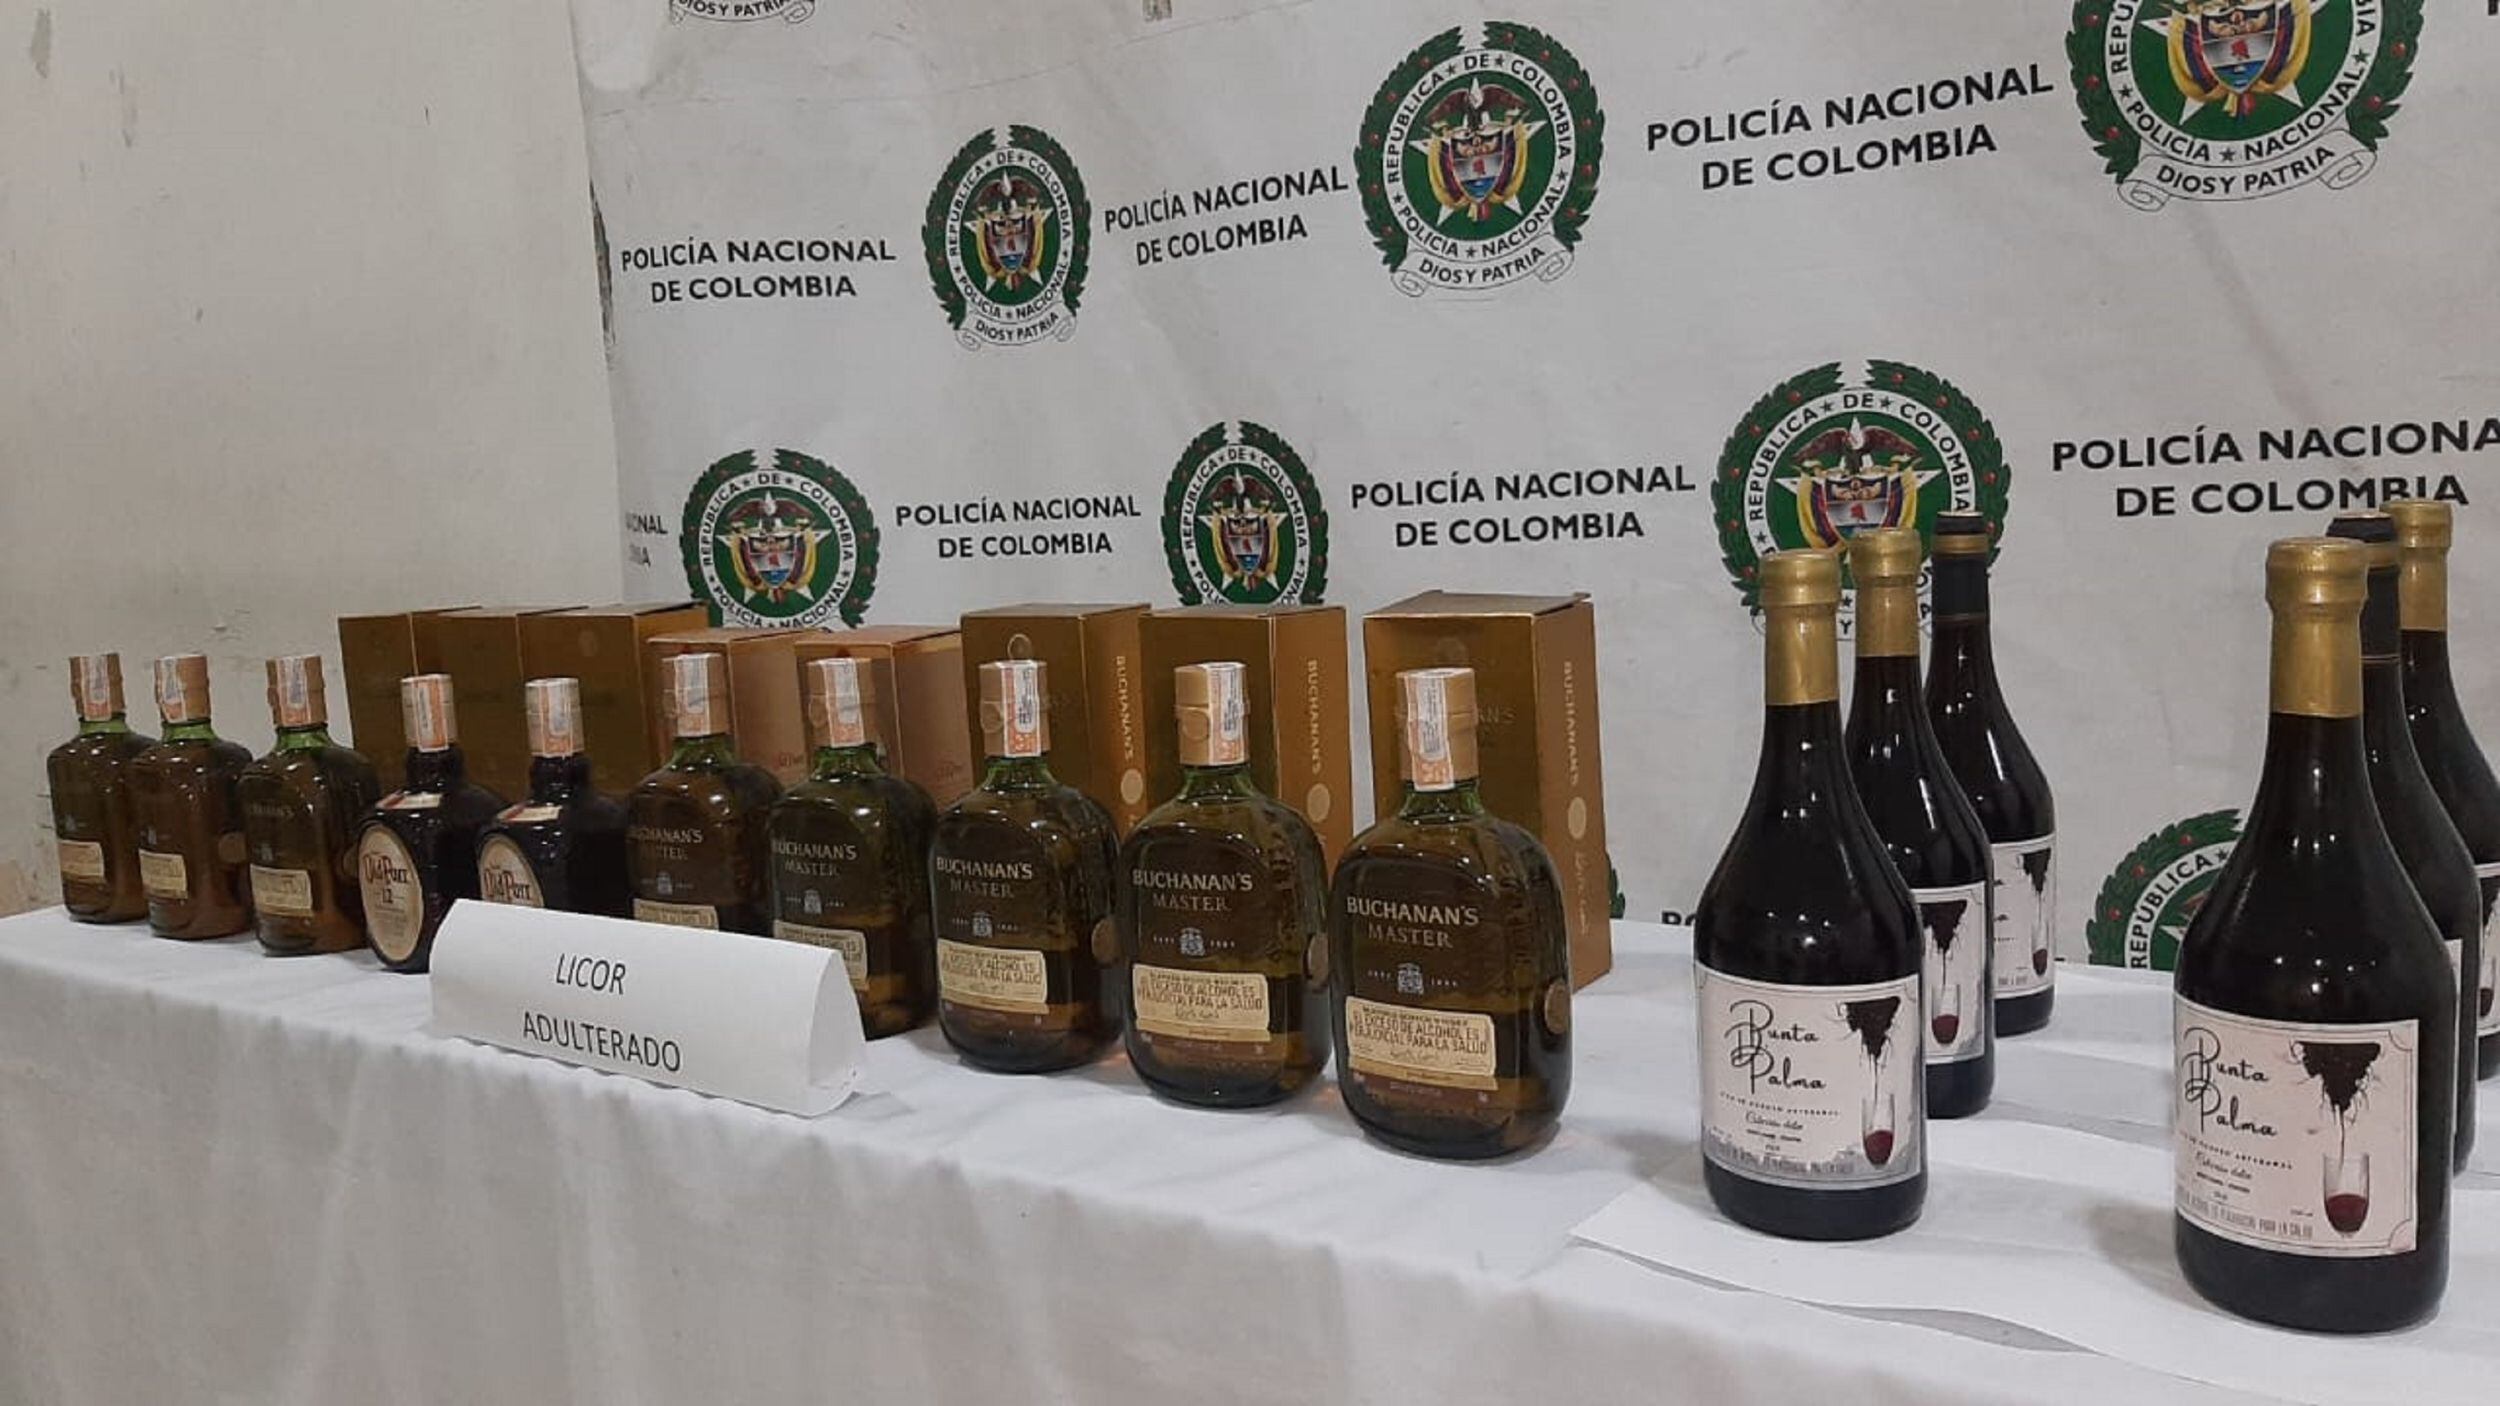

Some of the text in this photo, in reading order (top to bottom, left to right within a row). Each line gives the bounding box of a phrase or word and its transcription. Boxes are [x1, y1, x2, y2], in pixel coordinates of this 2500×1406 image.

[1387, 53, 1573, 184] REPUBLICA DE COLOMBIA
[1647, 63, 2054, 151] POLICÍA NACIONAL
[2126, 64, 2367, 162] POLICIA NACIONAL
[1702, 123, 1997, 190] DE COLOMBIA
[2244, 144, 2336, 192] PATRIA
[996, 150, 1015, 165] DE
[1029, 156, 1072, 241] COLOMBIA
[1104, 165, 1349, 233] POLICÍA NACIONAL
[1136, 214, 1308, 266] DE COLOMBIA
[1398, 183, 1566, 258] POLICIA NACIONAL
[621, 236, 897, 272] POLICÍA NACIONAL
[1482, 246, 1546, 283] PATRIA
[651, 275, 857, 303] DE COLOMBIA
[959, 262, 1069, 319] POLICIA NACIONAL
[1017, 310, 1060, 340] PATRIA
[1749, 393, 1971, 522] REPUBLICA DE COLOMBIA
[2052, 426, 2243, 471] POLICÍA
[1227, 447, 1248, 461] DE
[1261, 456, 1309, 548] COLOMBIA
[1351, 465, 1696, 509] POLICÍA NACIONAL
[2116, 475, 2469, 518] DE COLOMBIA
[757, 473, 781, 486] DE
[799, 480, 854, 562] COLOMBIA
[896, 495, 1141, 527] POLICÍA NACIONAL
[1396, 511, 1644, 547] DE COLOMBIA
[938, 532, 1112, 558] DE COLOMBIA
[936, 856, 1033, 880] BUCHANAN'S
[1132, 868, 1254, 891] BUCHANAN'S
[1153, 894, 1232, 912] MASTER
[1346, 896, 1480, 926] BUCHANAN'S
[1367, 923, 1454, 949] MASTER
[556, 953, 626, 995] LICOR
[523, 1011, 681, 1072] ADULTERADO
